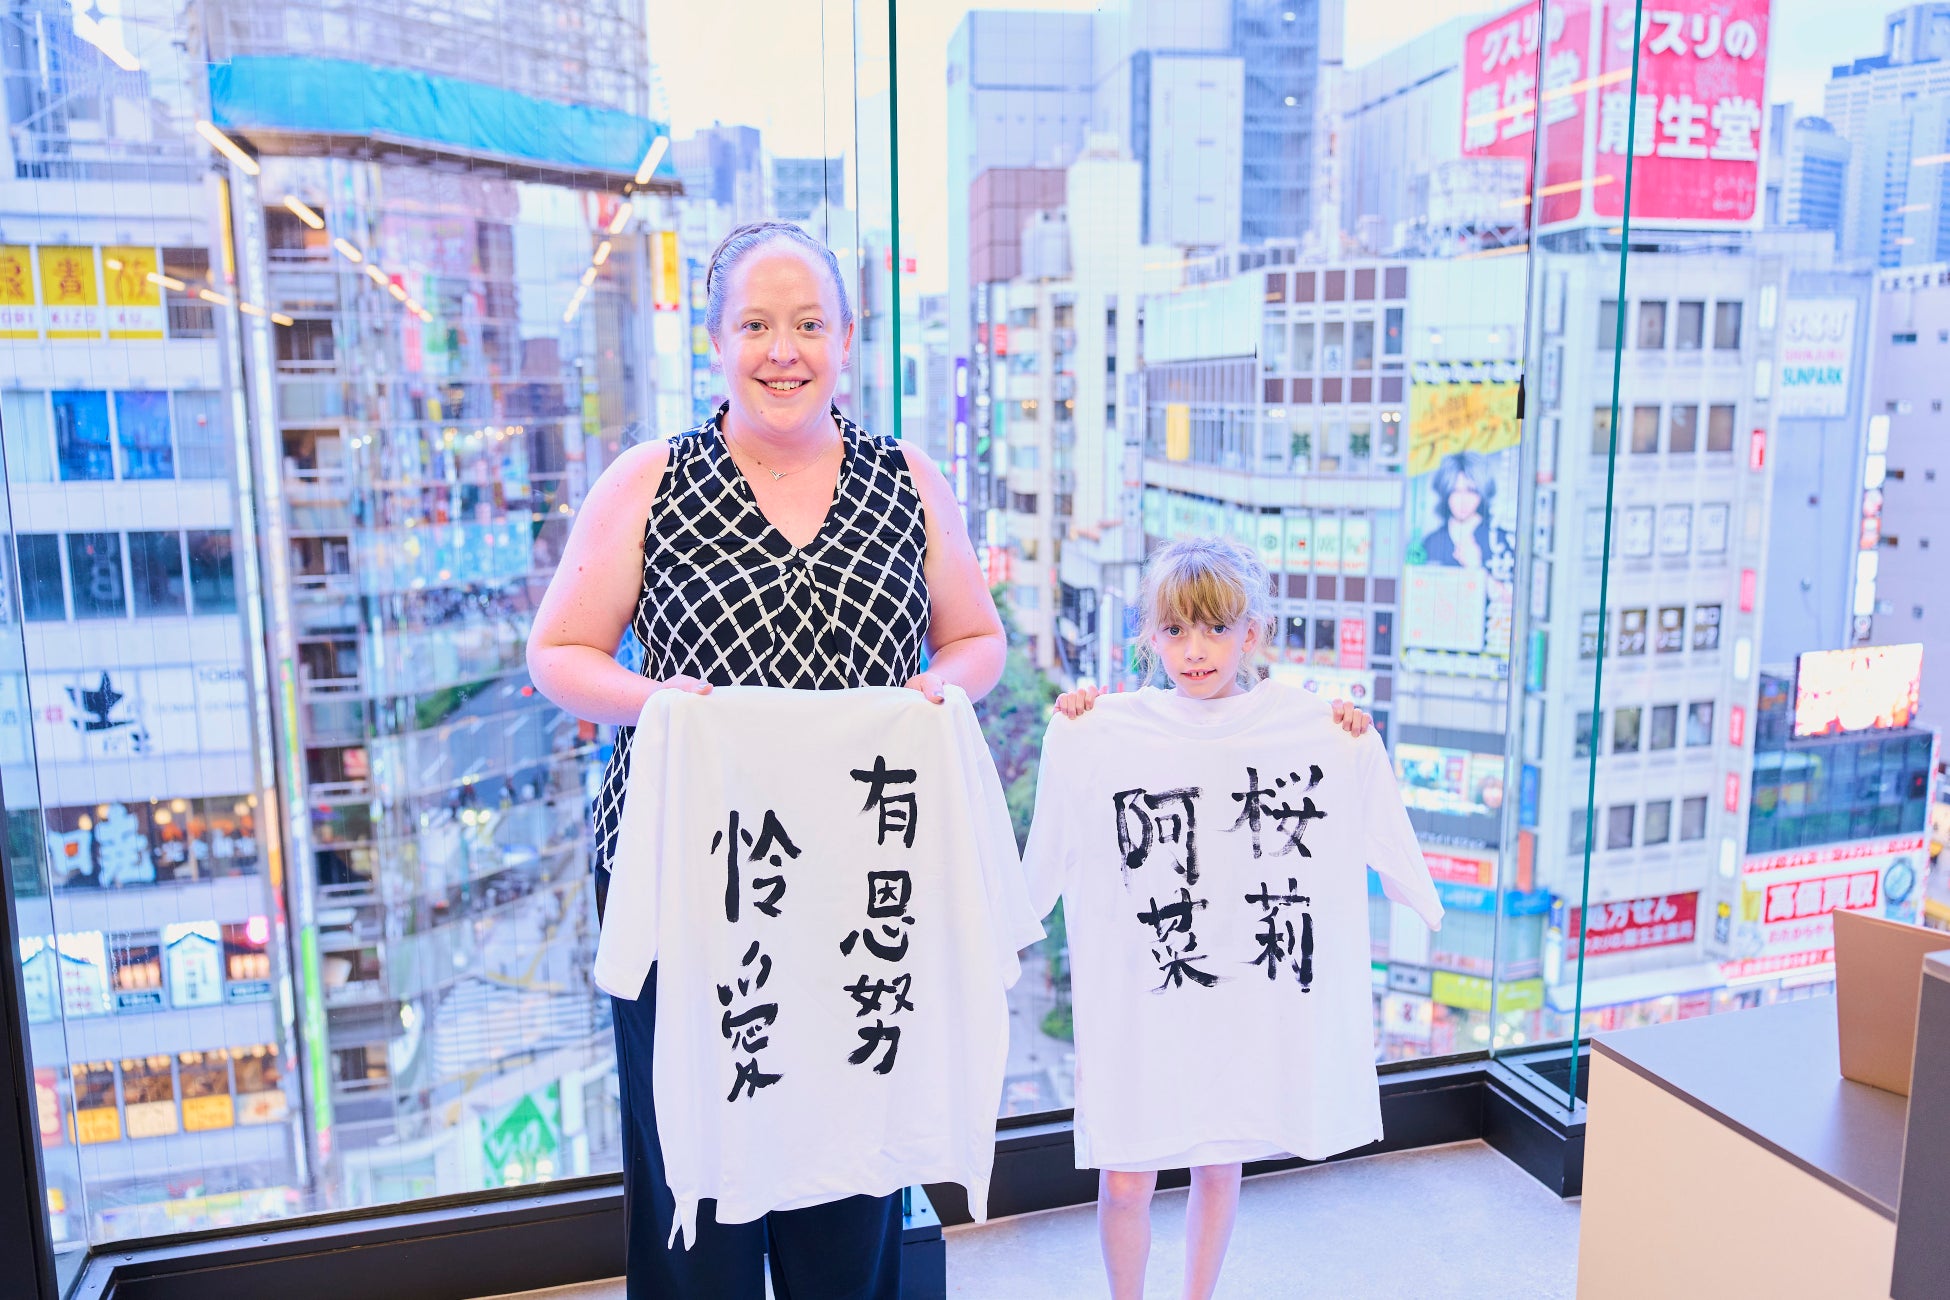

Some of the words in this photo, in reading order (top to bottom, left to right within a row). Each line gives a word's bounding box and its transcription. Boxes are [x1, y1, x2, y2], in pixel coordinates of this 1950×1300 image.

[1613, 8, 1758, 60] クスリの
[1599, 92, 1761, 161] 龍生堂
[1781, 365, 1843, 386] SUNPARK
[1220, 764, 1328, 993] 桜莉
[839, 754, 918, 1075] 有恩努力
